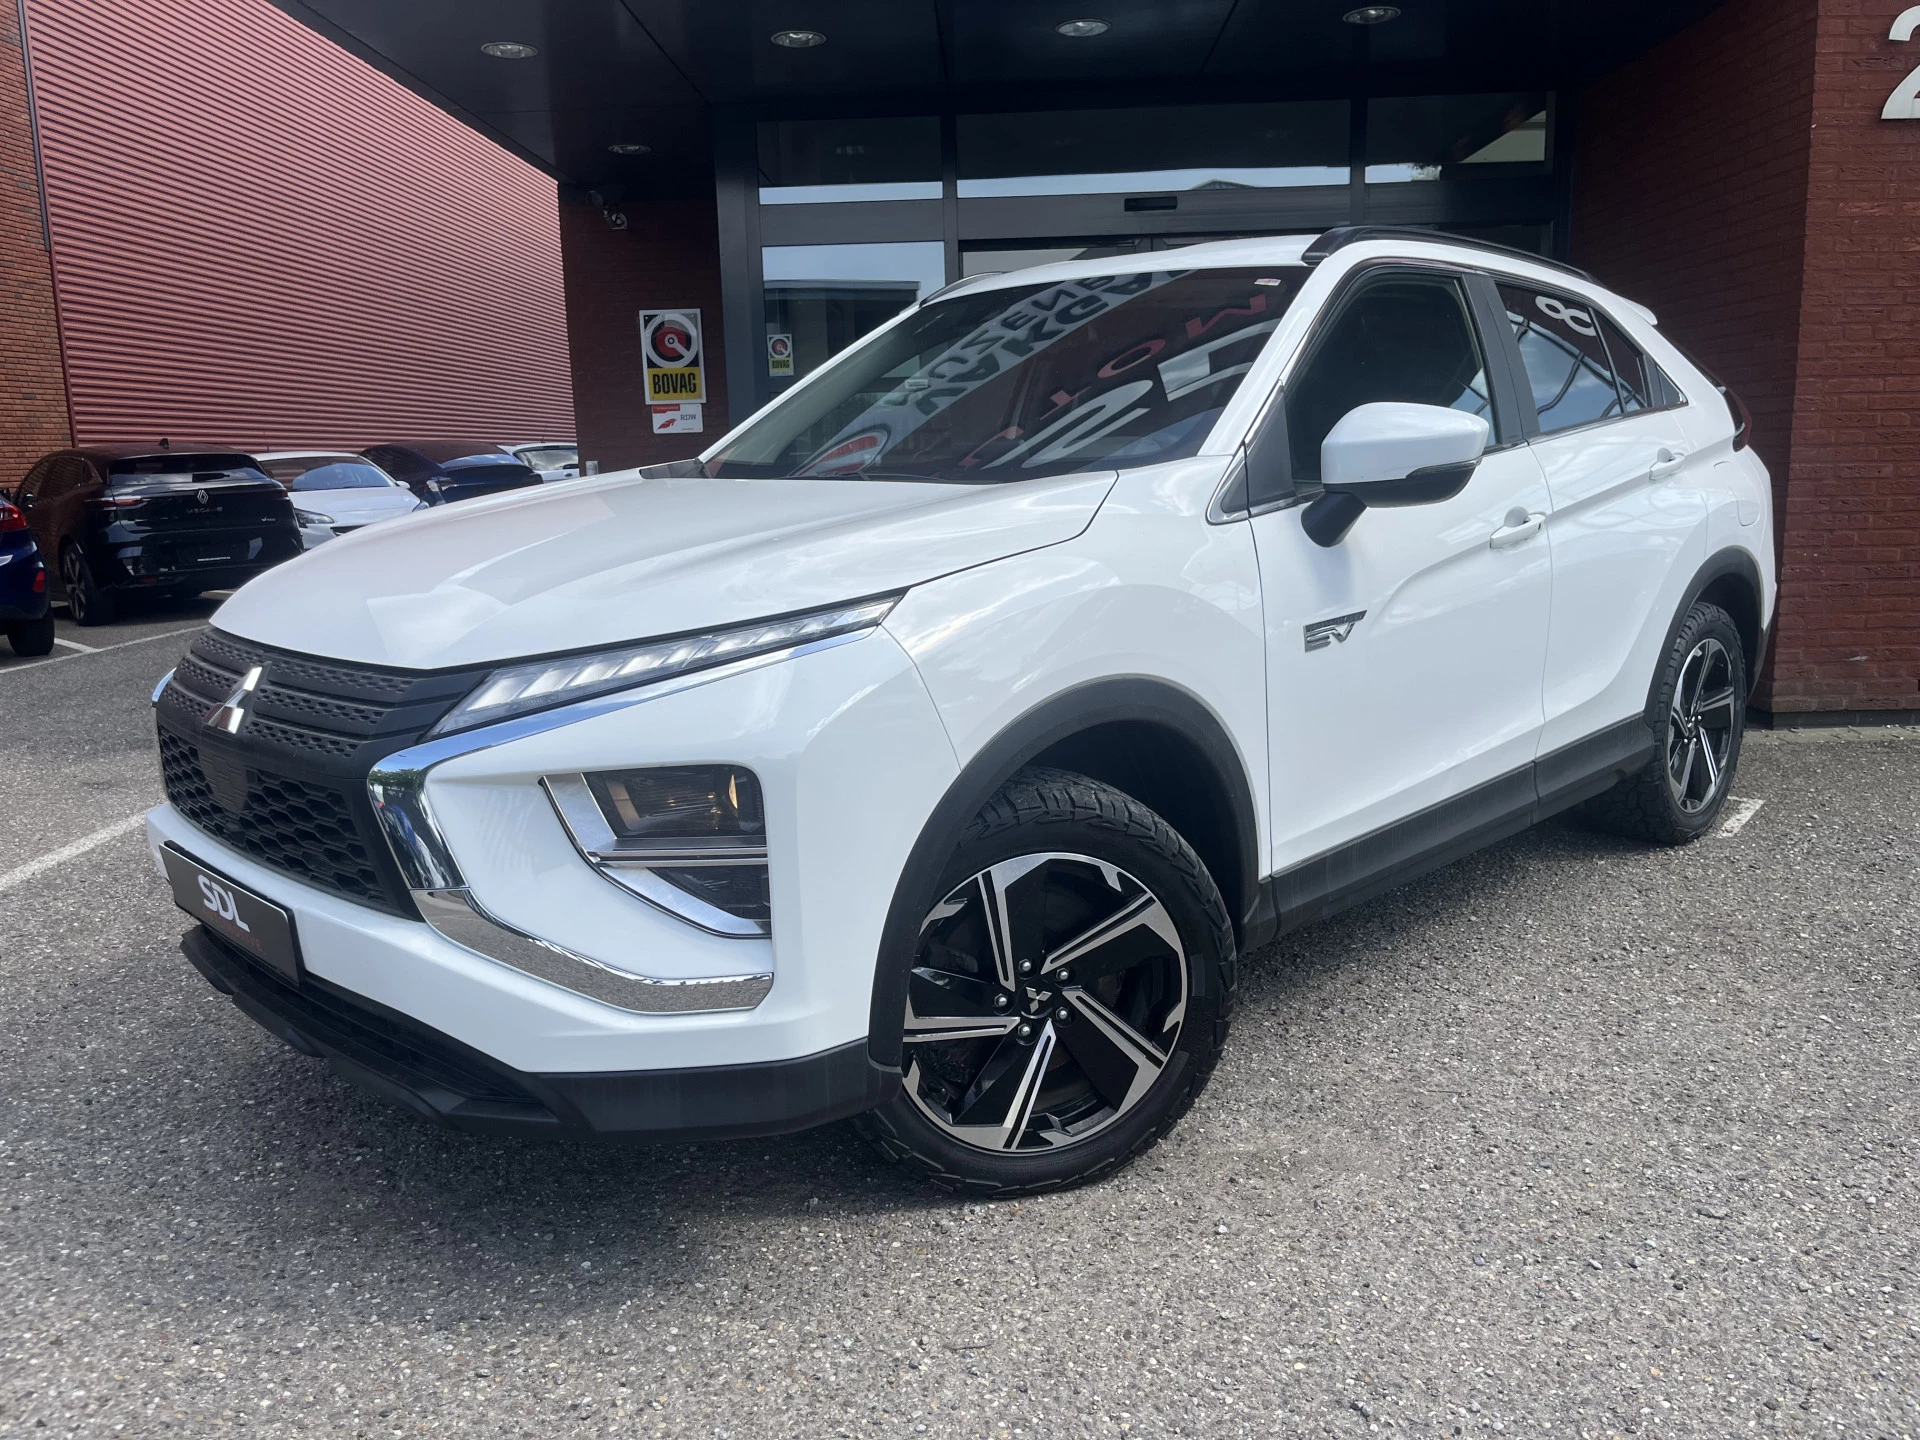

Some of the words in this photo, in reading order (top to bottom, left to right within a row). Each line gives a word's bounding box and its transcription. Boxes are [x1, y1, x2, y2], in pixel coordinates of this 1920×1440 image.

[771, 359, 791, 369] BOVAG
[652, 372, 697, 394] BOVAG
[198, 874, 250, 933] SDL
